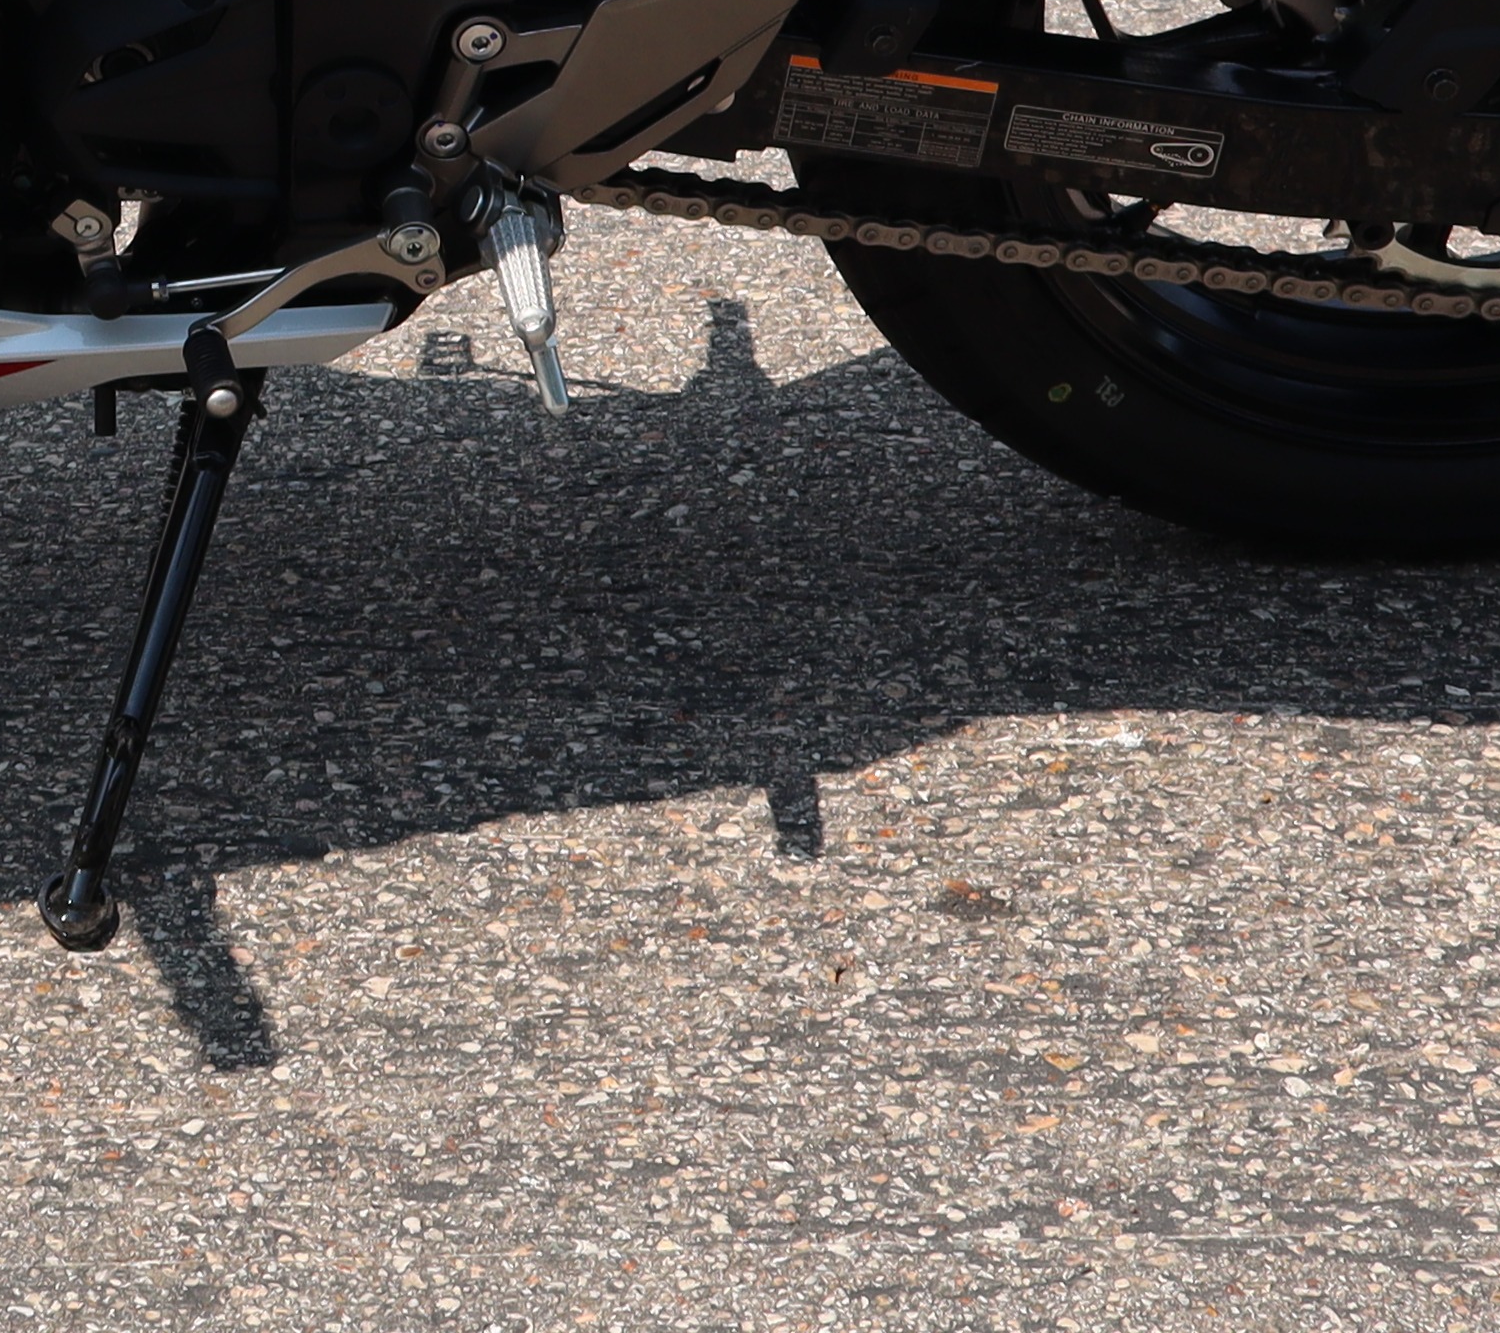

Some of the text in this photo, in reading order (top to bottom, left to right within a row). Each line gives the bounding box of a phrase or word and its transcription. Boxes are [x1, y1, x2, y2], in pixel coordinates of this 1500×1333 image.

[860, 101, 879, 112] AND
[884, 104, 910, 116] LOAD
[915, 109, 940, 120] DATA
[1062, 113, 1175, 136] CHAIN INFORMATION
